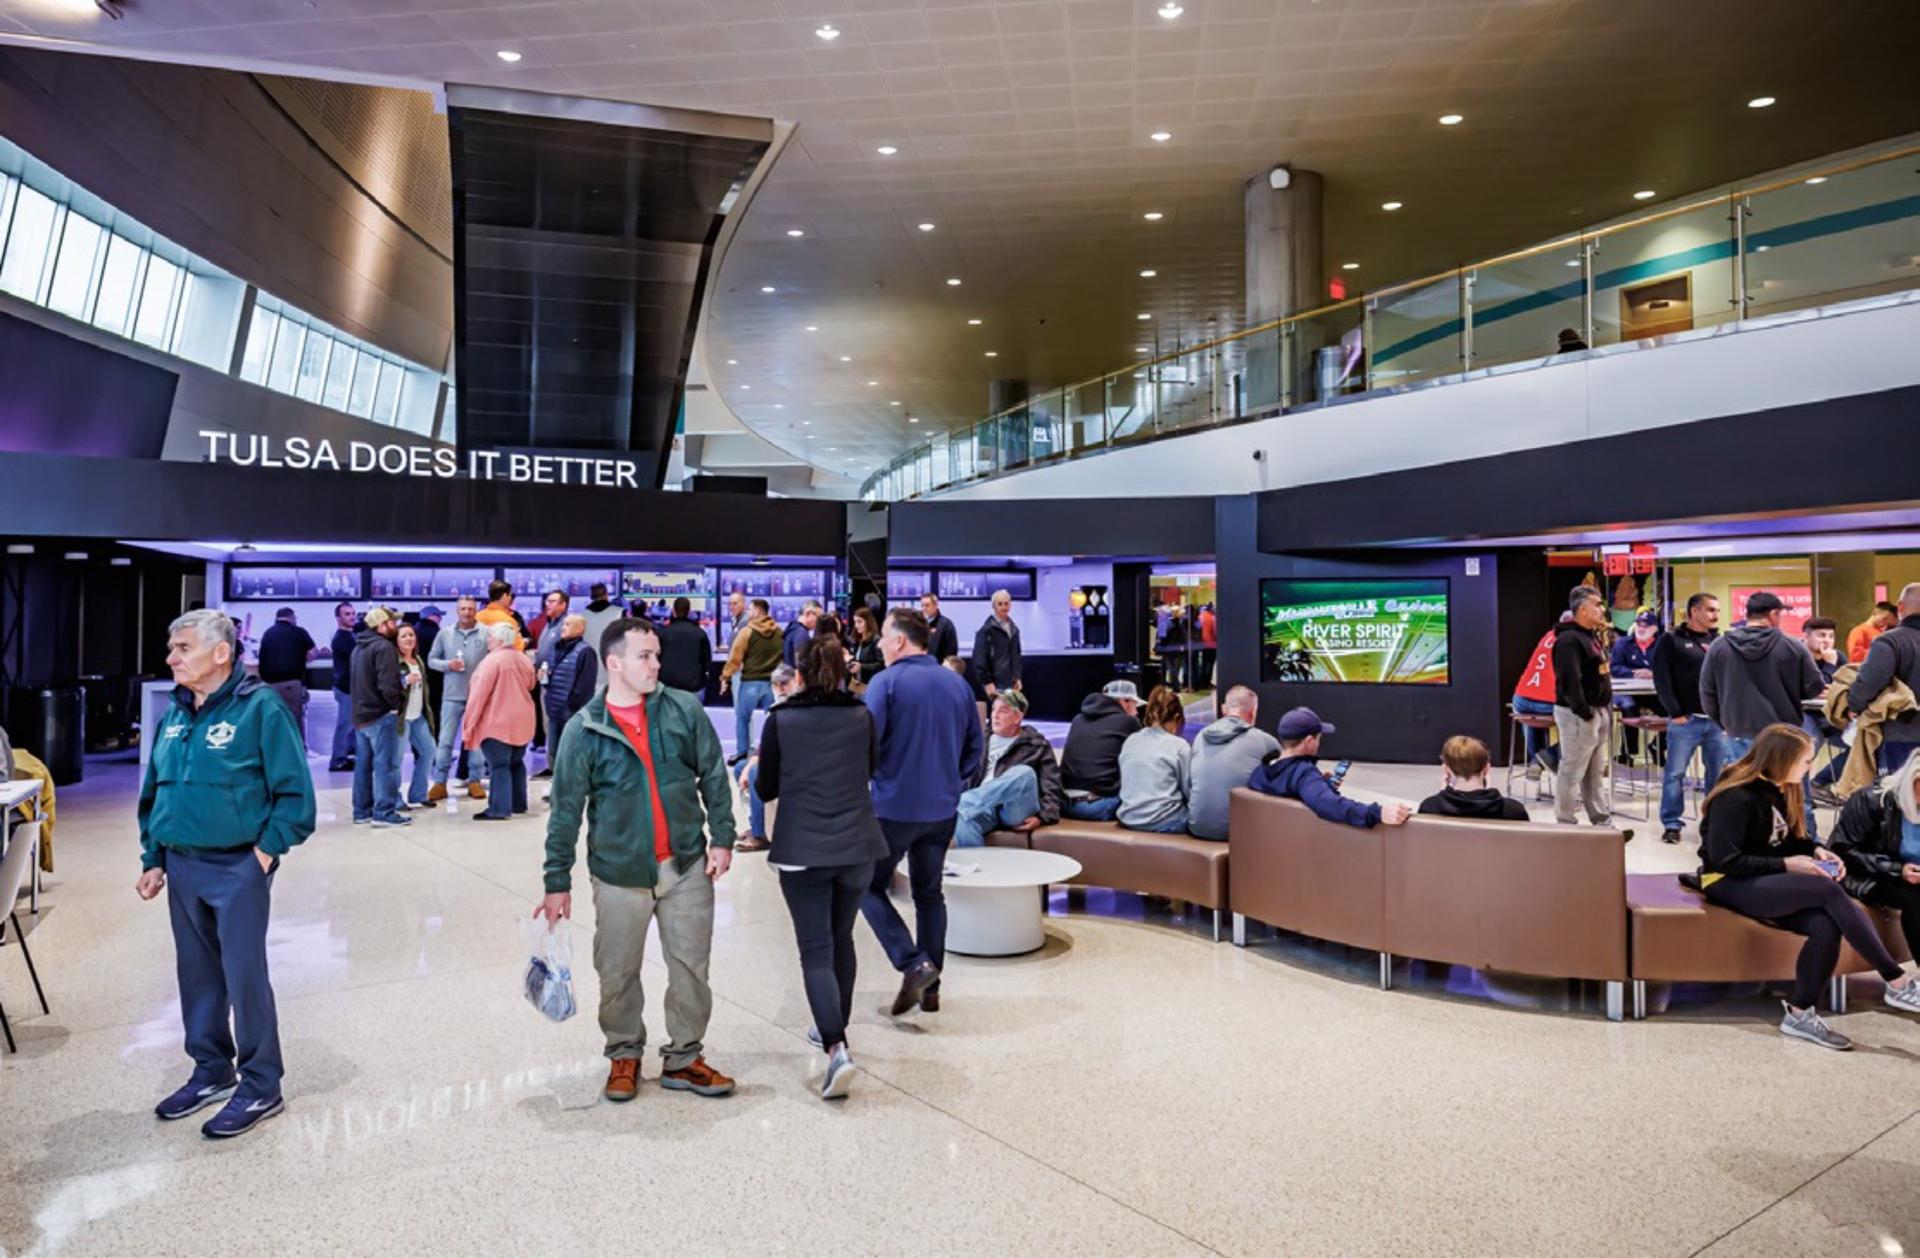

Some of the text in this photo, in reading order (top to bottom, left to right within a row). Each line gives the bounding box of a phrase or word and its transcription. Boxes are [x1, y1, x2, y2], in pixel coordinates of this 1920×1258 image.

[199, 431, 639, 488] TULSA DOES IT BETTER
[1303, 623, 1404, 638] RIVER SPIRIT
[1315, 639, 1391, 647] CASINO RESORT
